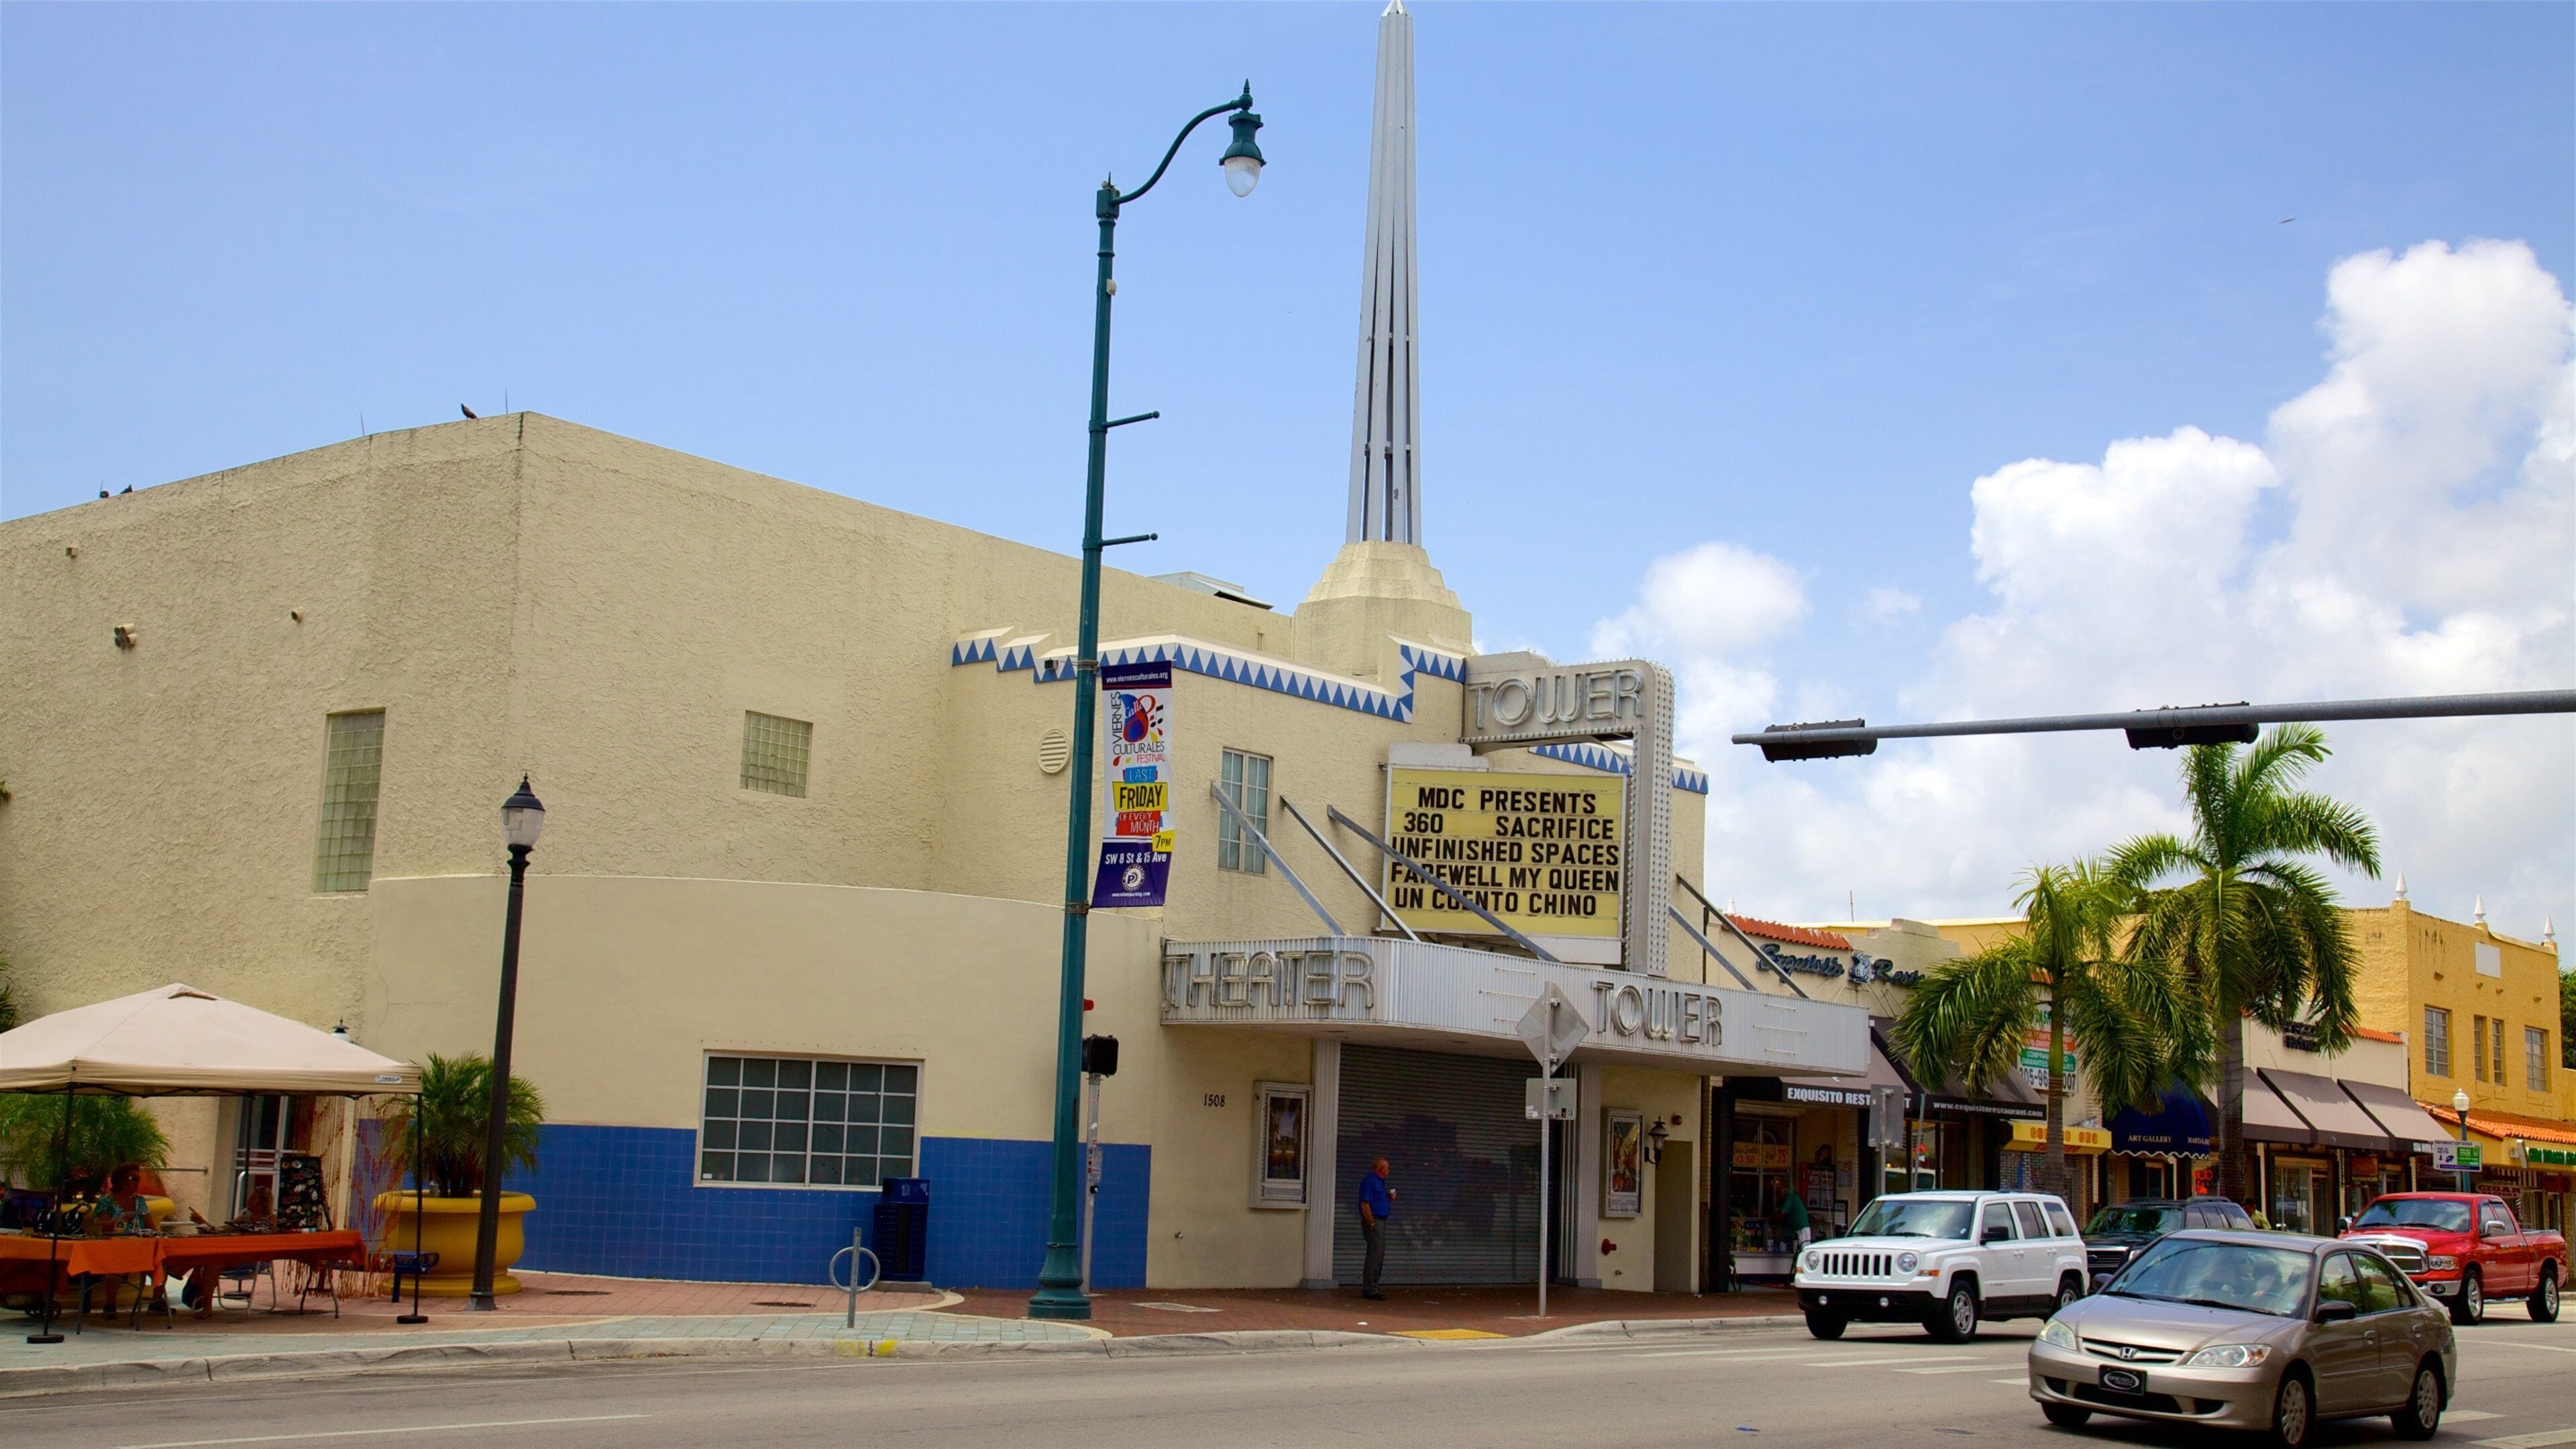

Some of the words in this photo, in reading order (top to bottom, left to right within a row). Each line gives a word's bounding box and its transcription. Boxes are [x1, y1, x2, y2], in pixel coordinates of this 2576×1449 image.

[1106, 672, 1169, 683] www.viernesculturales.org
[1468, 669, 1643, 729] TOWER
[1111, 692, 1122, 744] VIERNES
[1113, 741, 1165, 755] CULTURALES
[1137, 753, 1166, 763] FESTIVAL
[1130, 769, 1153, 782] LAST
[1120, 784, 1163, 809] FRIDAY
[1418, 787, 1465, 810] MDC
[1480, 790, 1597, 814] PRESENTS
[1120, 813, 1127, 821] OF
[1129, 812, 1153, 821] EVERY
[1130, 819, 1159, 833] MONTH
[1403, 812, 1444, 835] 360
[1495, 816, 1614, 840] SACRIFICE
[1104, 853, 1118, 865] SW
[1119, 853, 1124, 864] 8
[1126, 852, 1135, 863] St
[1136, 852, 1142, 863] &
[1144, 852, 1150, 863] 15
[1152, 851, 1167, 863] Ave
[1392, 837, 1522, 863] UNFINISHED
[1531, 842, 1619, 866] SPACES
[1391, 861, 1503, 888] FAREWELL
[1509, 867, 1542, 890] MY
[1549, 869, 1619, 892] QUEEN
[1395, 887, 1424, 908] UN
[1432, 889, 1519, 912] CUENTO
[1529, 892, 1597, 916] CHINO
[1162, 951, 1375, 1008] THEATER
[1590, 980, 1723, 1047] TOWER
[2022, 1058, 2048, 1067] DIAMANTES
[1204, 1093, 1226, 1107] 1508
[1787, 1087, 1843, 1104] EXQUISITO
[1933, 1101, 2043, 1118] www.exquisitorestaurant.com
[2079, 1131, 2098, 1144] ORO
[2477, 1185, 2521, 1193] CIGAR
